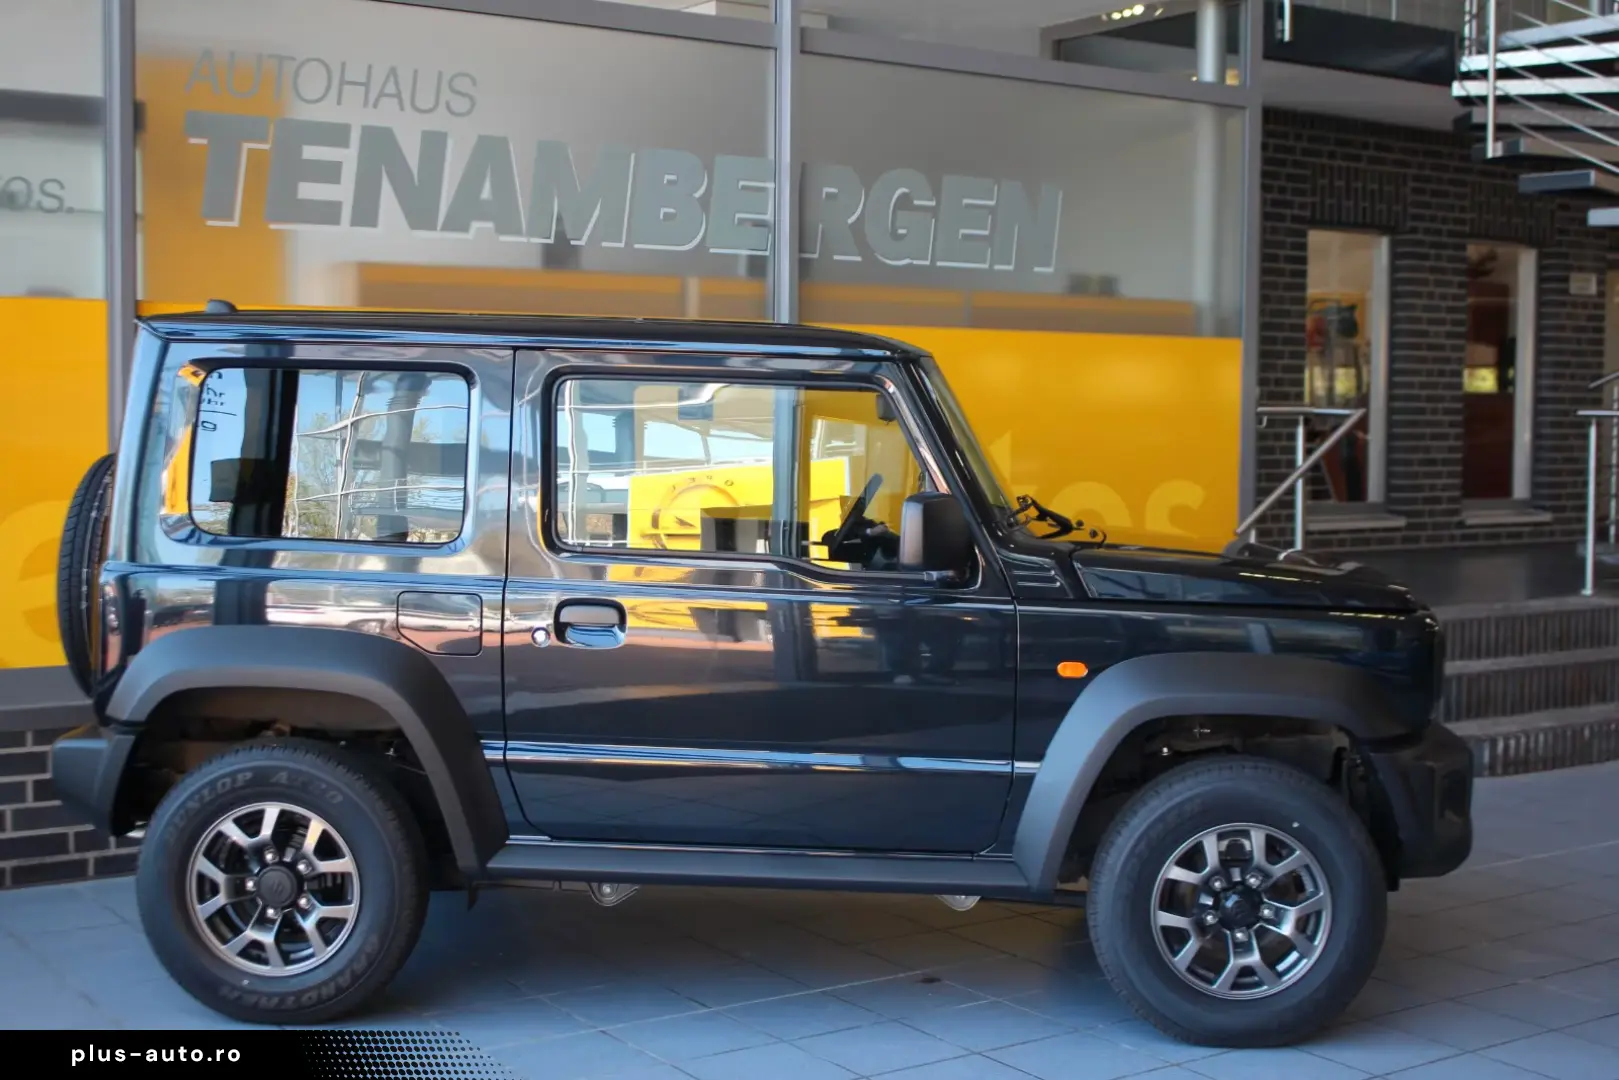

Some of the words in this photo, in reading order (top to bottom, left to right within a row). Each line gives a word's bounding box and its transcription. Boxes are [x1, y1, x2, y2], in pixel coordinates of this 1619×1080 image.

[184, 46, 479, 118] AUTOHAUS
[182, 109, 1063, 274] TENAMBERGEN
[166, 770, 255, 843] DUNLOP
